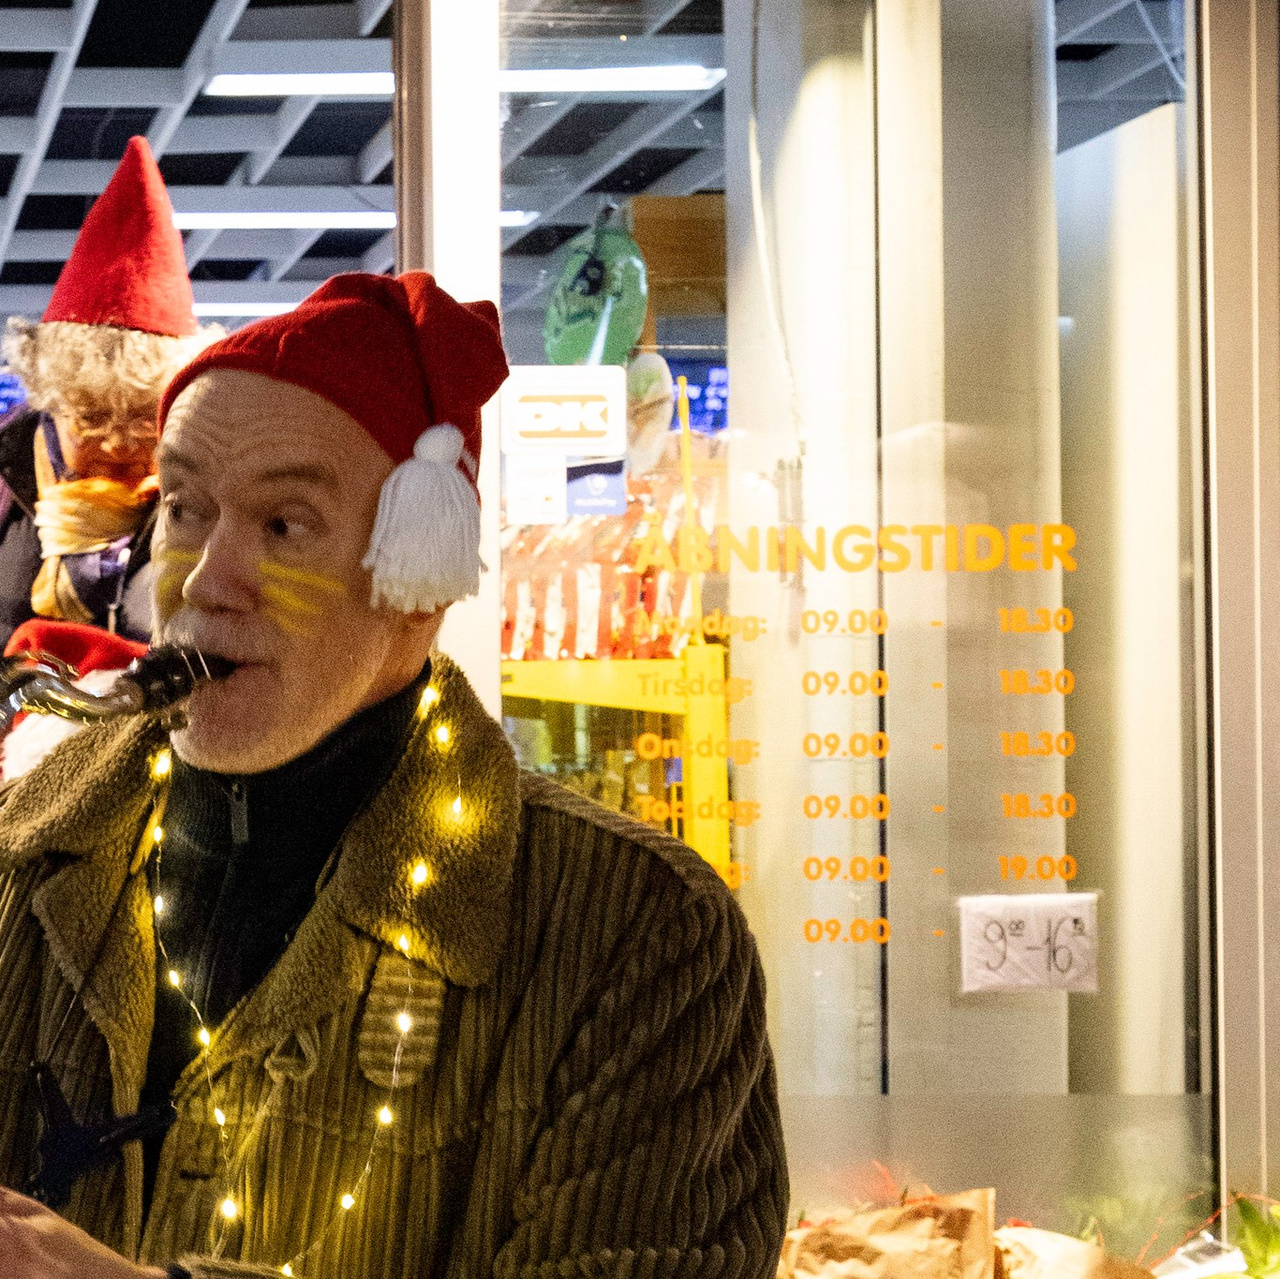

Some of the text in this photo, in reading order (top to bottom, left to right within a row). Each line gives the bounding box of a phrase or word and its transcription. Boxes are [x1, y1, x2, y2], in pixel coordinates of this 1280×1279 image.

[634, 510, 1078, 573] ÅBNINGSTIDER
[801, 608, 889, 634] 09.00
[998, 607, 1075, 633] 18.30
[801, 669, 889, 696] 09.00
[999, 669, 1075, 695] 18.30
[802, 731, 890, 758] 09.00
[999, 731, 1076, 757] 18.30
[802, 793, 891, 820] 09.00
[1000, 792, 1077, 819] 18.30
[802, 856, 891, 882] 09.00
[998, 855, 1078, 881] 19.00
[803, 918, 891, 944] 09.00
